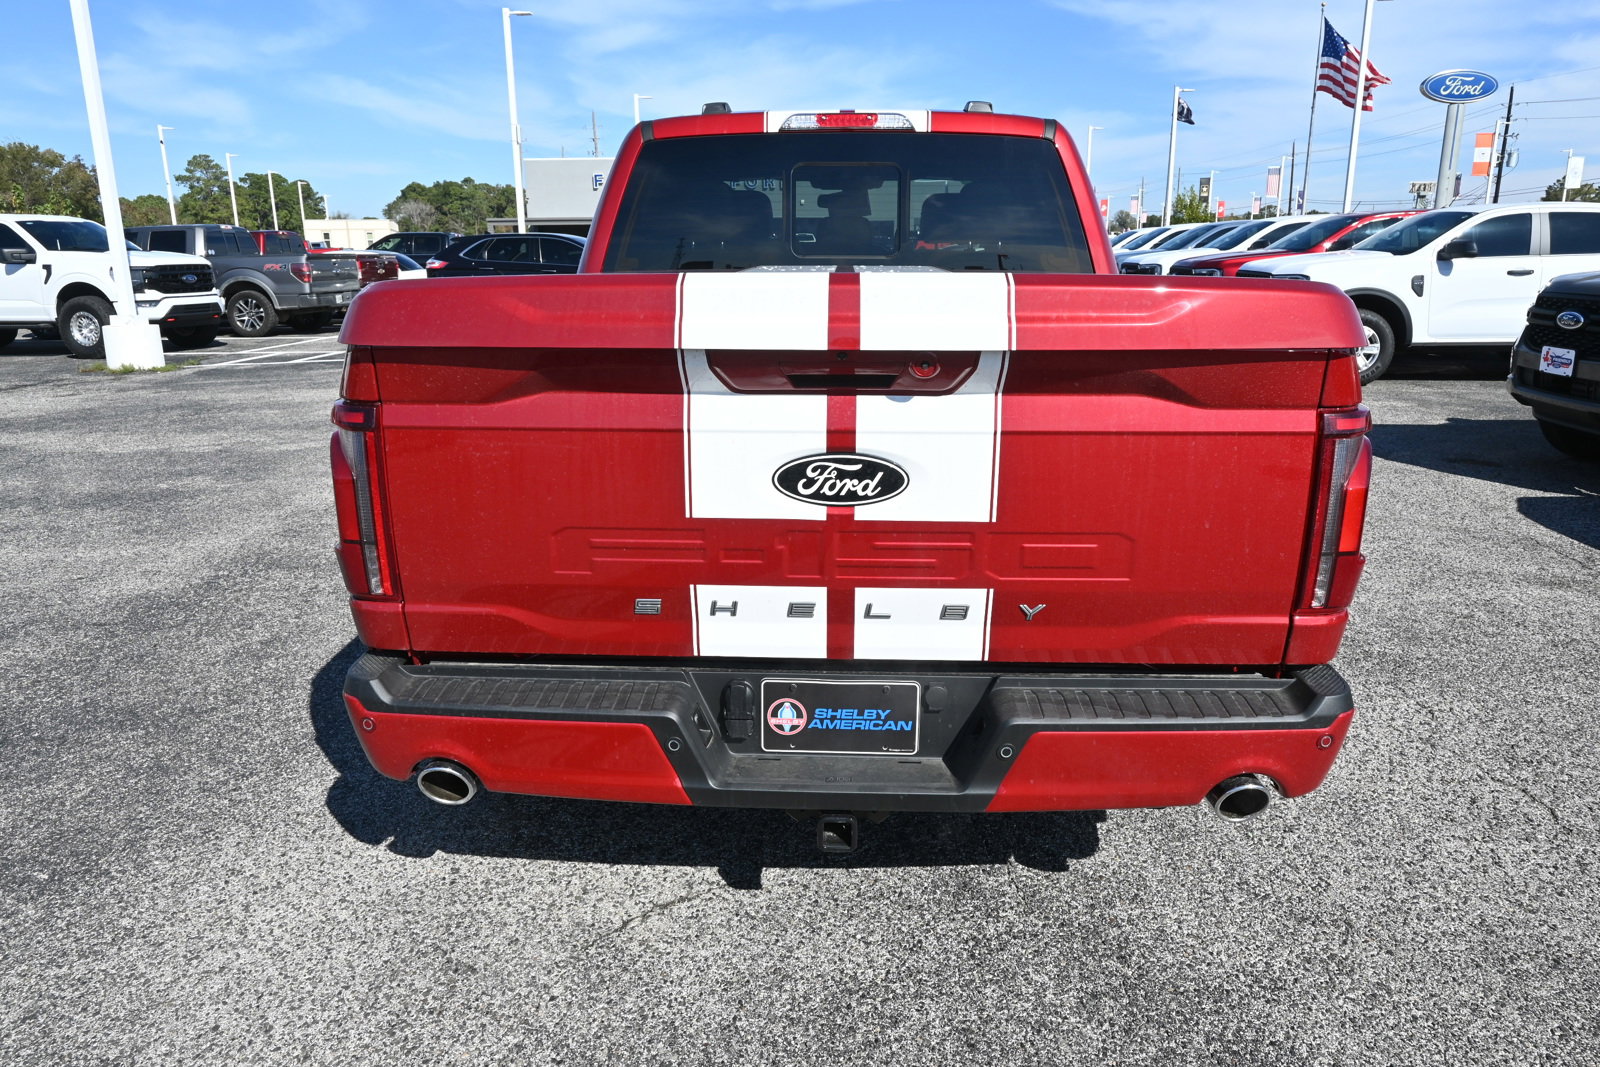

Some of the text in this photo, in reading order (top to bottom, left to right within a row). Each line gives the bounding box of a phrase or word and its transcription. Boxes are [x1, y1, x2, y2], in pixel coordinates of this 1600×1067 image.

[1440, 76, 1485, 95] Ford
[730, 179, 783, 189] FOR
[797, 461, 884, 497] Ford
[551, 526, 1137, 582] F-150
[633, 597, 1046, 621] SHELBY
[814, 708, 891, 720] SHELBY
[808, 719, 913, 731] AMERICAN
